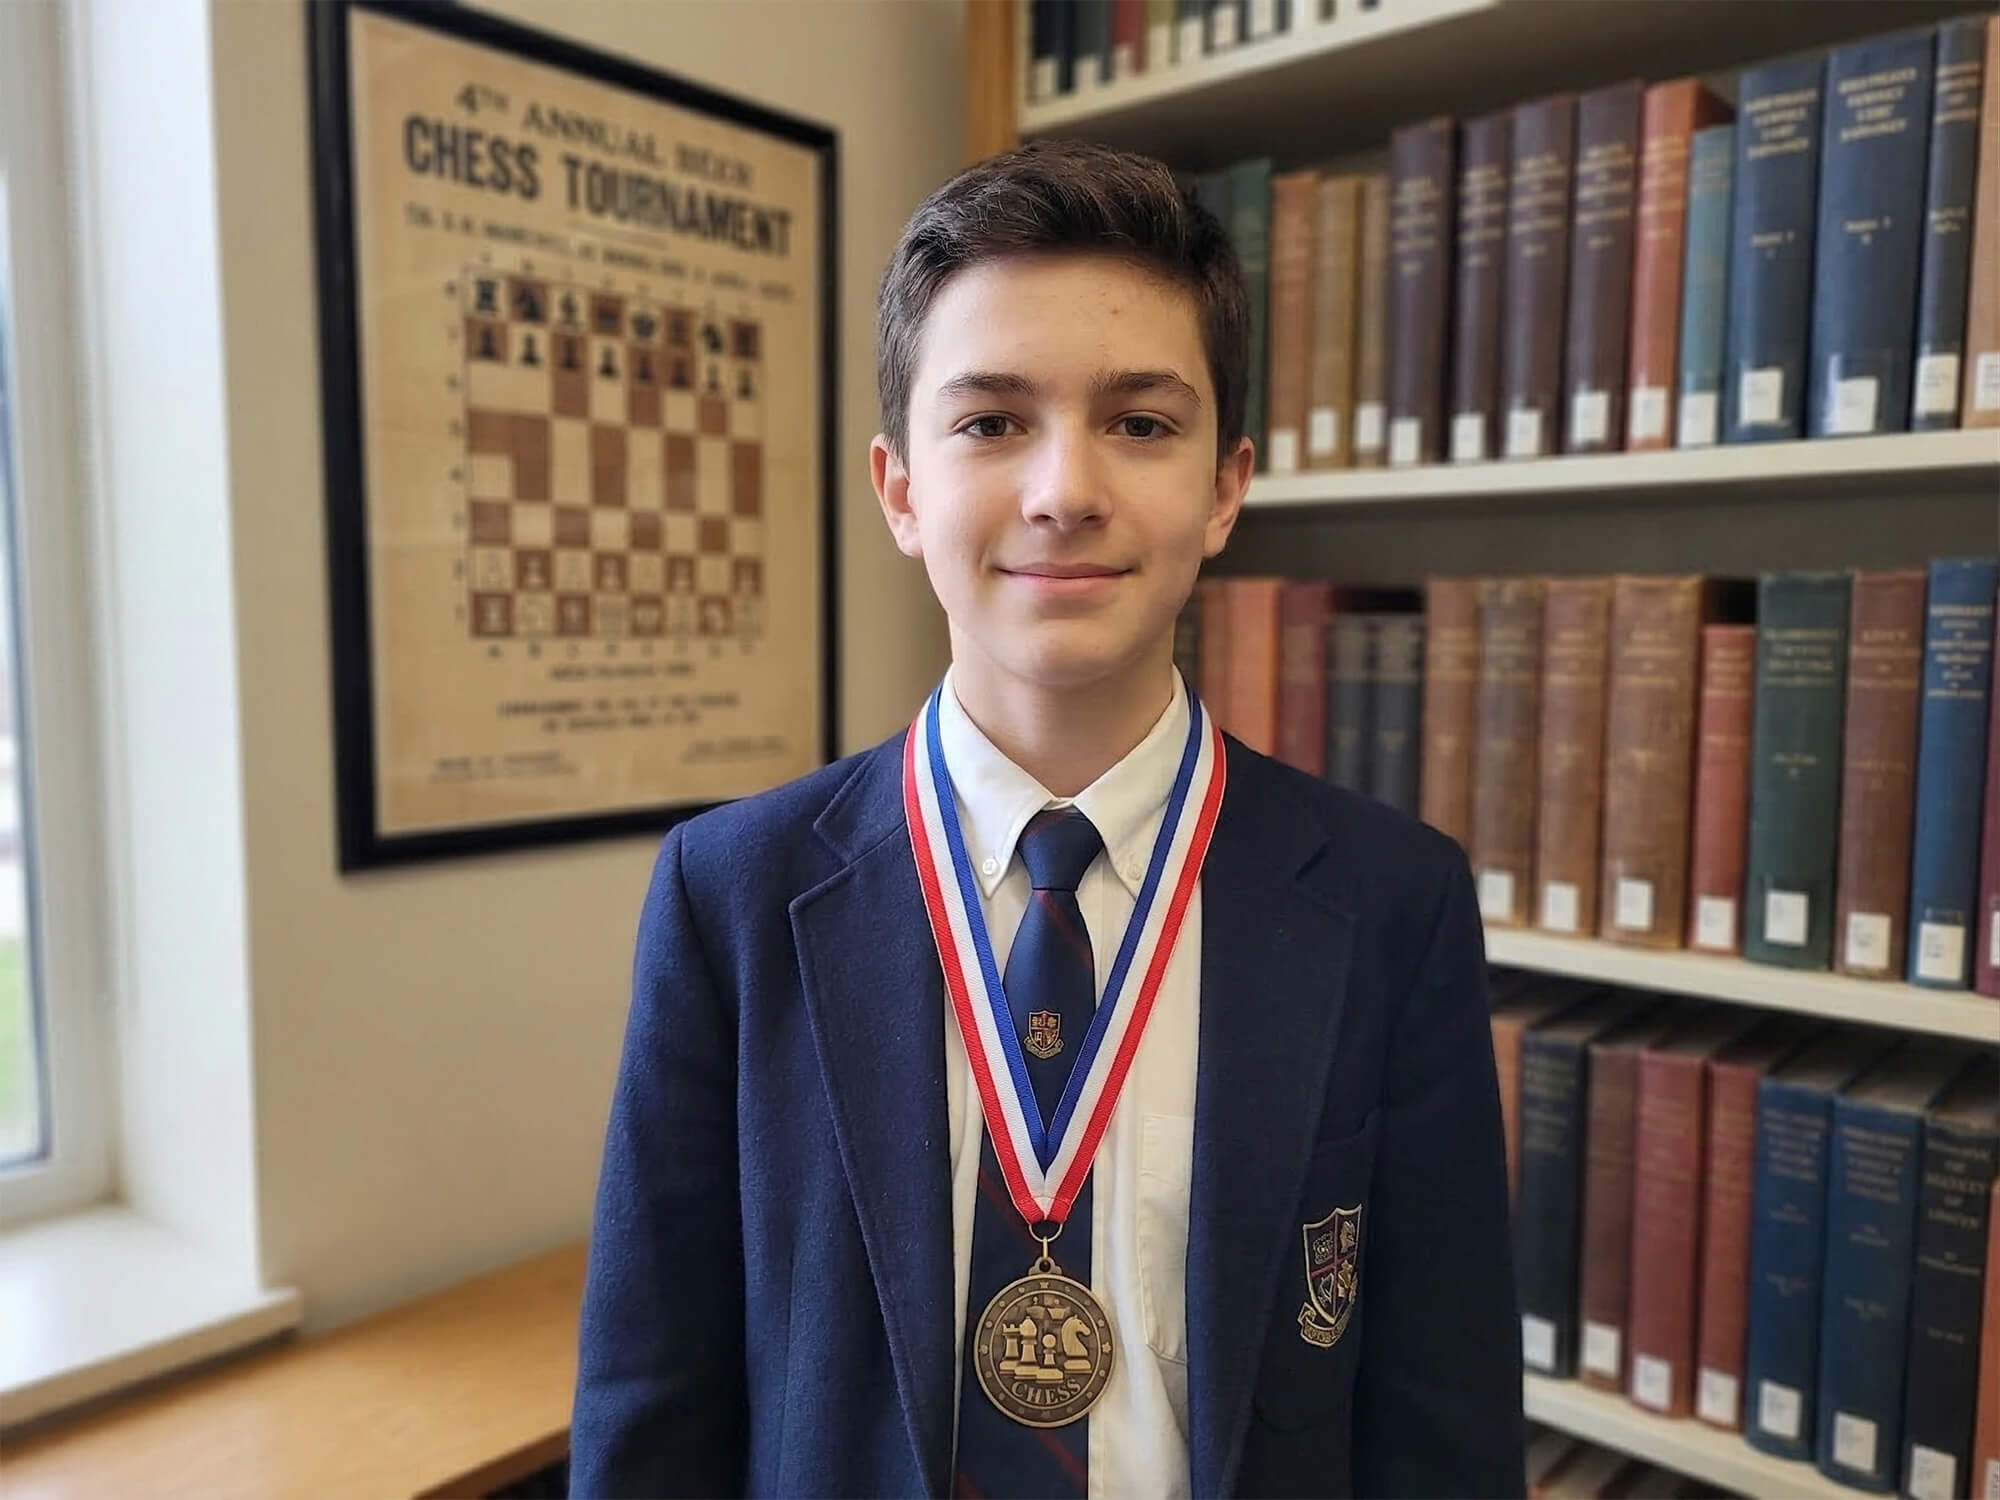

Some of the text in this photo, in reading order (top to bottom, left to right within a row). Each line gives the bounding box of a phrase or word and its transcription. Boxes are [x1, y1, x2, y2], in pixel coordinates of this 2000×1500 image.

[522, 103, 661, 165] ANNUAL
[404, 114, 539, 200] CHESS
[561, 154, 792, 257] TOURNAMENT
[1011, 1379, 1081, 1405] CHESS
